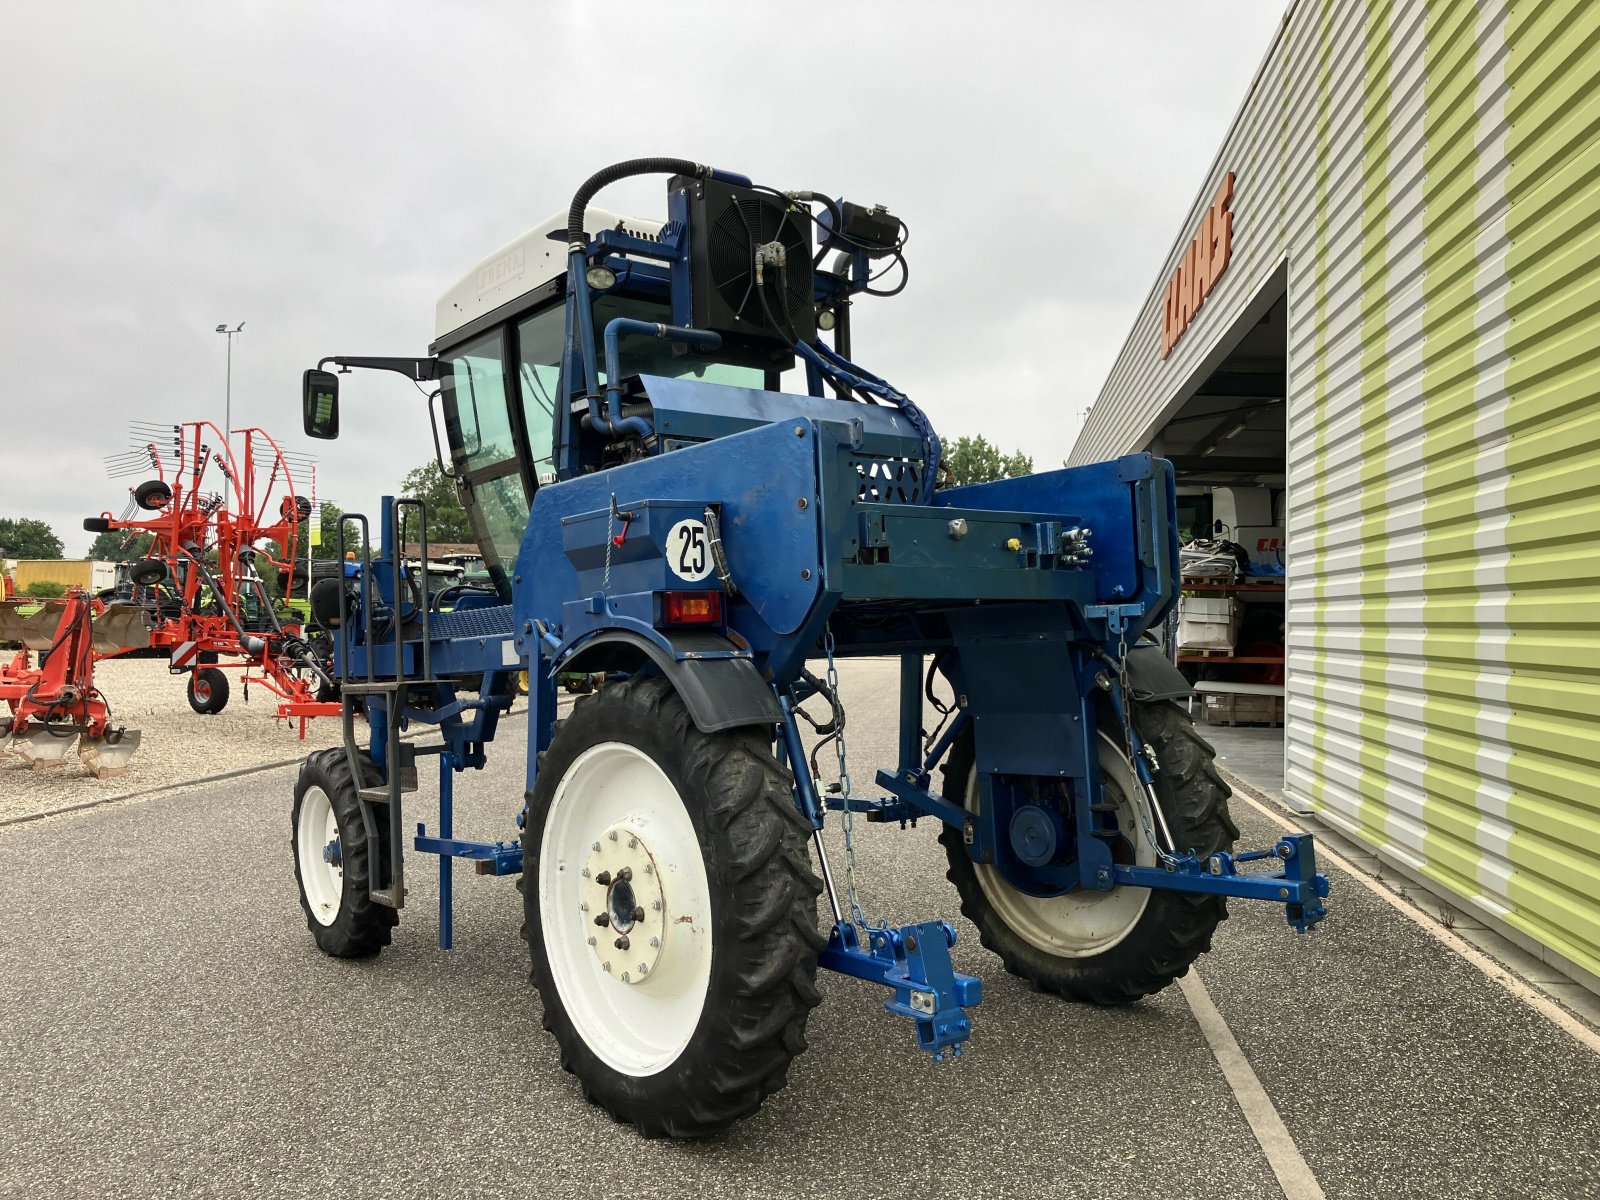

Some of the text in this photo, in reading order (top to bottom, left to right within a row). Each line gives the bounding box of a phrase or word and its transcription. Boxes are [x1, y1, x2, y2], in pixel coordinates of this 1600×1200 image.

[480, 251, 523, 289] FREMA
[1160, 172, 1235, 360] CLAAS
[679, 525, 705, 574] 25
